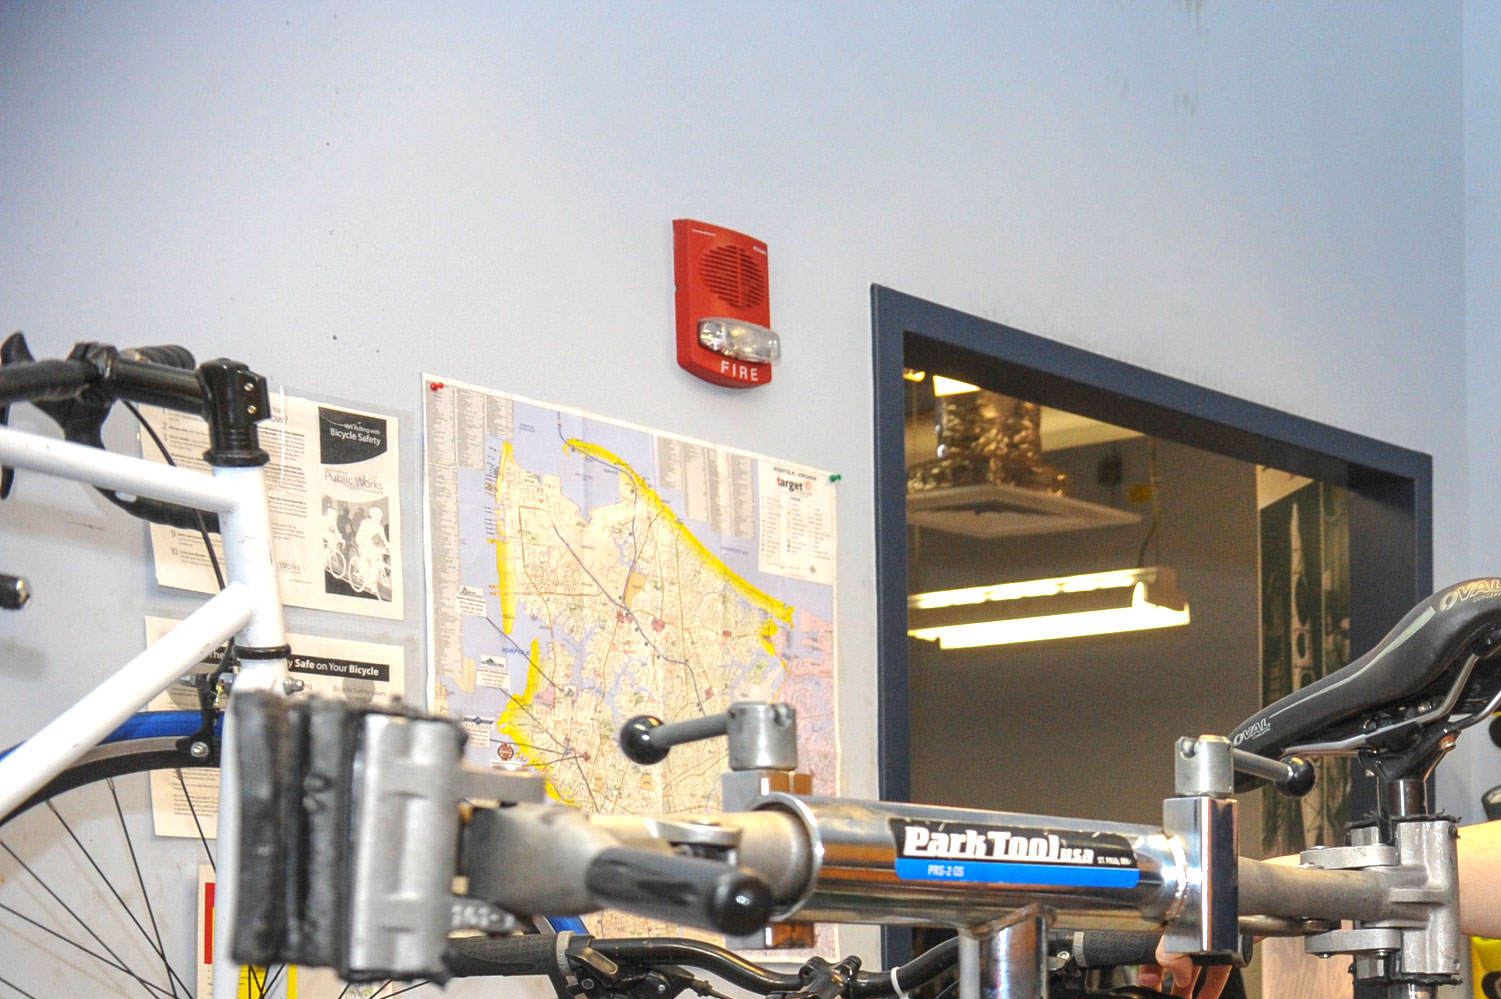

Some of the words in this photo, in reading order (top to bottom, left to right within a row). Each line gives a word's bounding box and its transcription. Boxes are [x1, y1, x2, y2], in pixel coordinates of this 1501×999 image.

[720, 360, 759, 381] FIRE
[329, 427, 358, 441] Bicycle
[357, 432, 382, 447] Safety
[324, 470, 353, 486] Public
[354, 475, 383, 491] Works
[776, 476, 803, 493] target
[208, 651, 225, 660] The
[294, 658, 315, 670] Safe
[316, 662, 328, 671] on
[328, 662, 348, 673] Your
[348, 664, 380, 677] Bicycle
[1232, 718, 1271, 747] OVAL
[902, 826, 988, 860] Park
[987, 830, 1060, 863] Tool
[1060, 847, 1095, 865] usa
